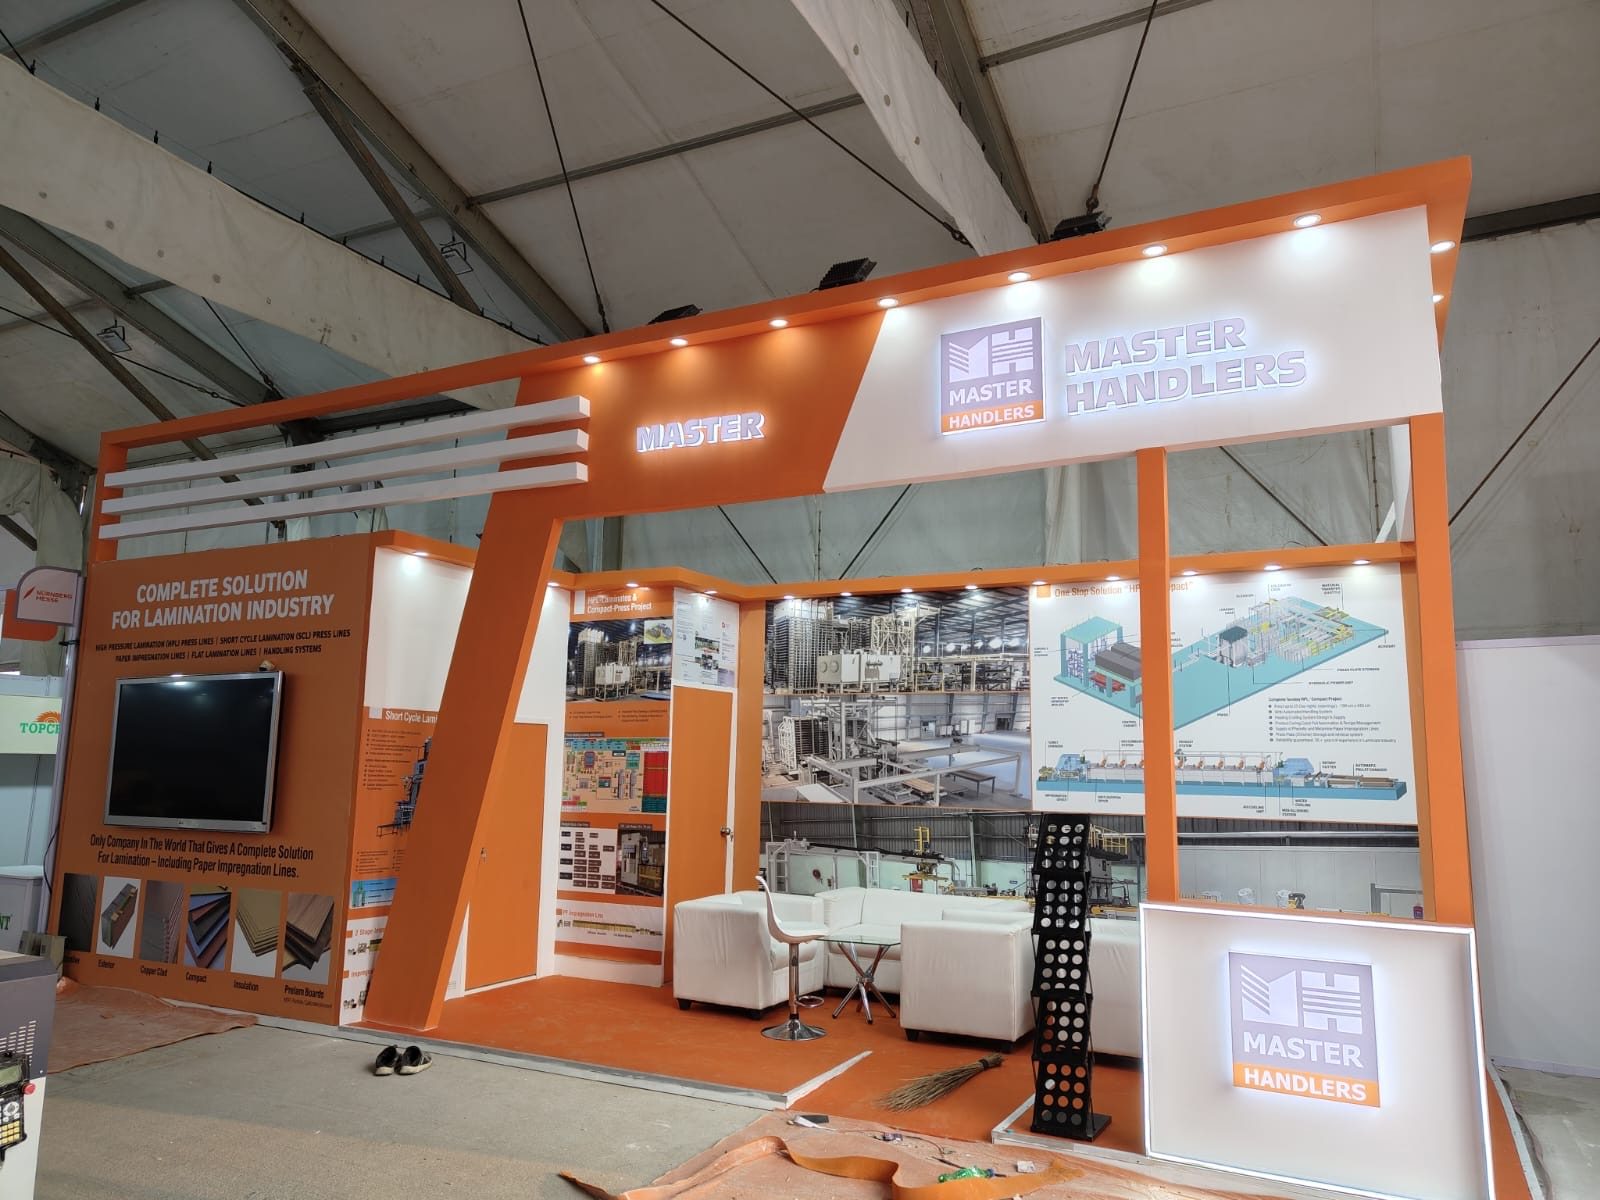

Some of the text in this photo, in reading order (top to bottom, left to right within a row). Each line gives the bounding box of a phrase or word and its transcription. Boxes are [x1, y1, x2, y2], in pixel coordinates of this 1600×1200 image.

[1065, 317, 1247, 375] MASTER
[949, 378, 1033, 406] MASTER
[1066, 350, 1306, 415] HANDLERS
[949, 405, 1035, 429] HANDLERS
[636, 411, 765, 453] MASTER
[136, 569, 308, 603] COMPLETE SOLUTION
[1055, 588, 1070, 597] One
[1071, 587, 1089, 598] Stop
[1090, 585, 1122, 596] Solution
[111, 593, 335, 630] FOR LAMINATION INDUSTRY
[631, 601, 652, 613] Project
[134, 640, 165, 650] LAMINATION
[181, 638, 198, 647] PRESS
[199, 637, 214, 646] LINES
[220, 635, 239, 645] SHORT
[240, 635, 258, 643] CYCLE
[259, 633, 295, 643] LAMINATION
[296, 631, 311, 640] (SCL)
[312, 630, 332, 640] PRESS
[333, 629, 351, 638] LINES
[170, 652, 186, 660] LINES
[191, 650, 205, 659] FLAT
[205, 648, 240, 658] LAMINATION
[241, 648, 257, 657] LINES
[263, 646, 294, 656] HANDLING
[295, 644, 322, 654] SYSTEMS
[385, 710, 438, 724] Short Cycle Lami
[90, 833, 314, 860] Only Company In The World That Gives A Complete Solution
[97, 851, 110, 863] For
[111, 852, 150, 867] Lamination
[158, 855, 192, 872] Including
[193, 858, 216, 874] Paper
[217, 859, 271, 877] Impregnation
[273, 863, 299, 878] Lines.
[185, 972, 207, 983] Compact
[1243, 1031, 1364, 1069] MASTER
[1244, 1067, 1367, 1102] HANDLERS
